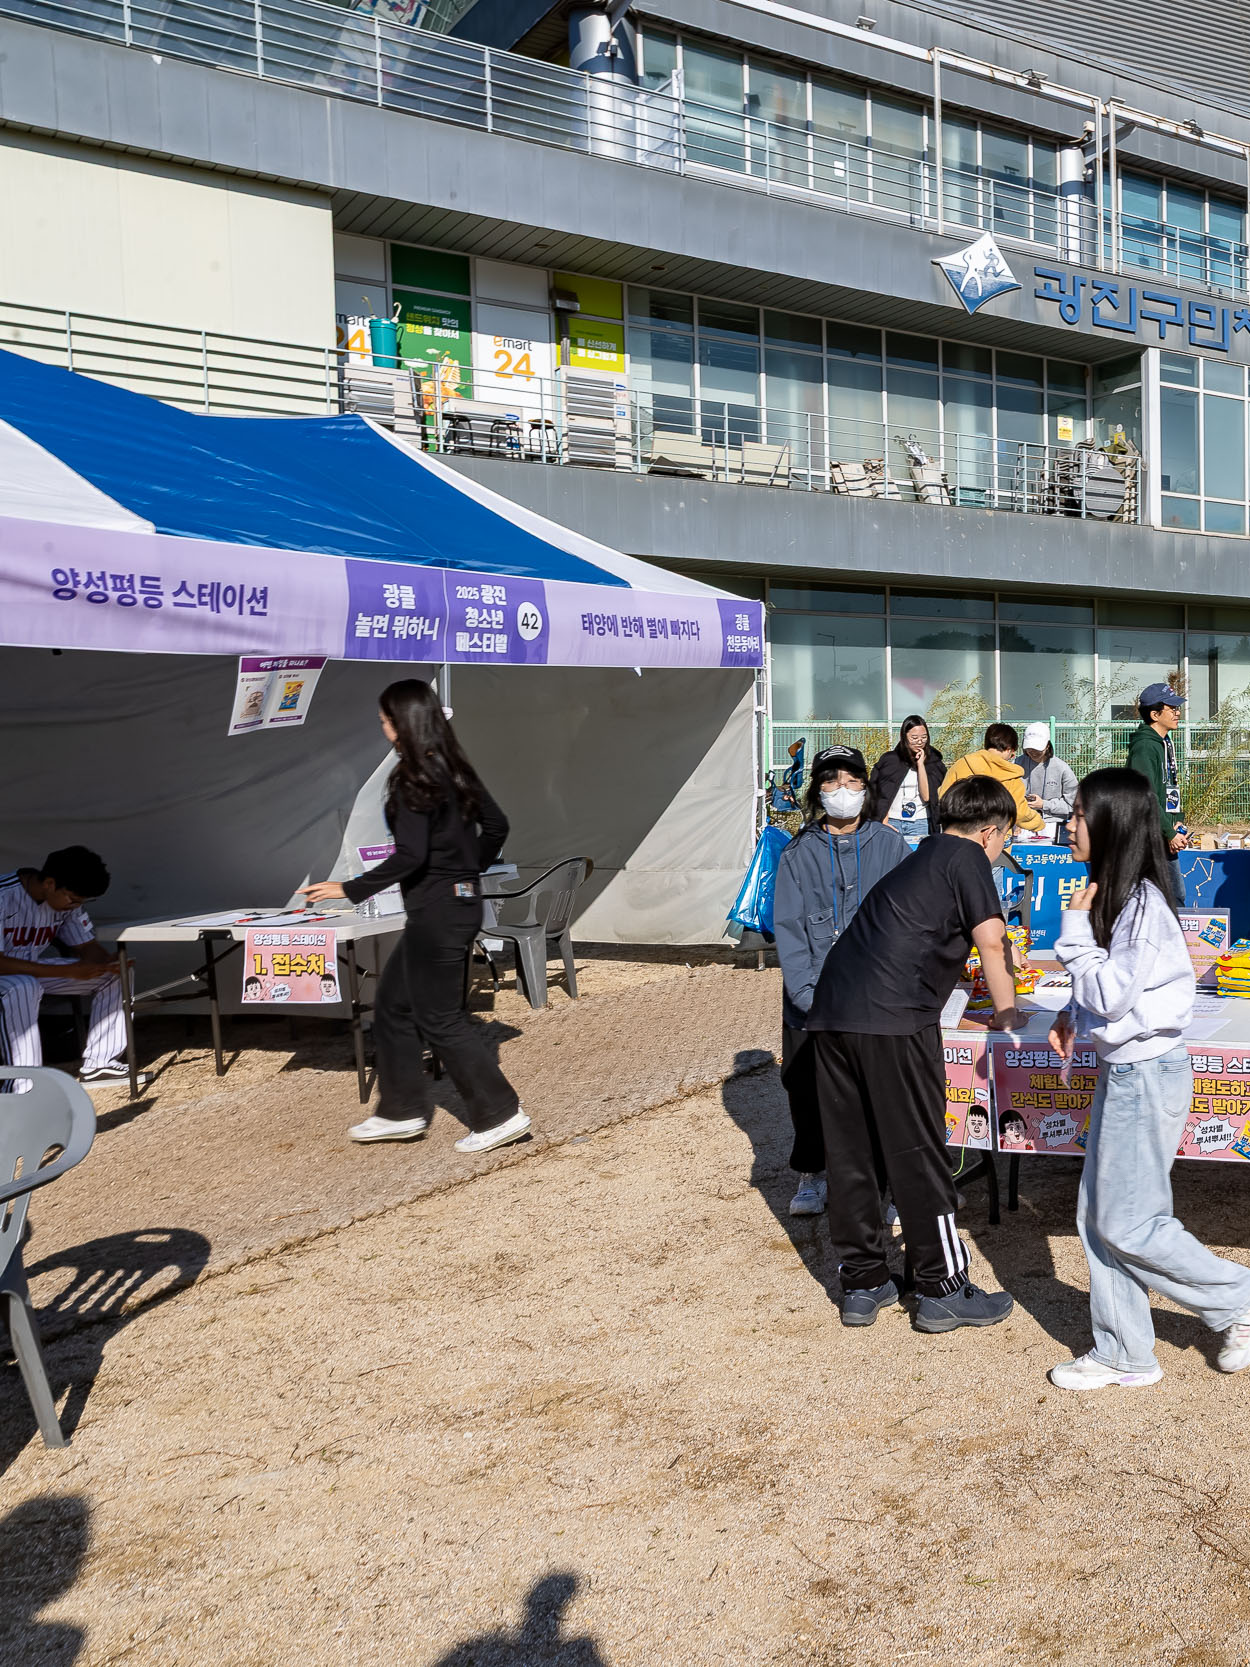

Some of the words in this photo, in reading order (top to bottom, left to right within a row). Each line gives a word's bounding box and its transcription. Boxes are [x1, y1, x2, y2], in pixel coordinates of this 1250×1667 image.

[493, 335, 532, 351] emart
[494, 349, 535, 382] 24
[51, 568, 163, 609] 양성평등
[172, 580, 269, 617] 스테이션
[382, 584, 416, 609] 광클
[456, 586, 479, 600] 2025
[480, 584, 507, 606] 광진
[355, 613, 389, 638] 놀면
[392, 615, 440, 641] 뭐하니
[465, 607, 504, 629] 청소년
[521, 613, 539, 630] 42
[581, 613, 619, 638] 태양에
[621, 616, 645, 639] 반해
[646, 617, 669, 640] 별에
[670, 619, 701, 641] 빠지다
[455, 632, 508, 654] 페스티벌
[726, 635, 761, 653] 천문동아리
[253, 933, 290, 946] 양성평등
[291, 933, 327, 946] 스테이션
[253, 953, 268, 975] 1.
[271, 953, 326, 977] 접수처
[1188, 1054, 1224, 1073] 평등
[1011, 1092, 1052, 1108] 간식도
